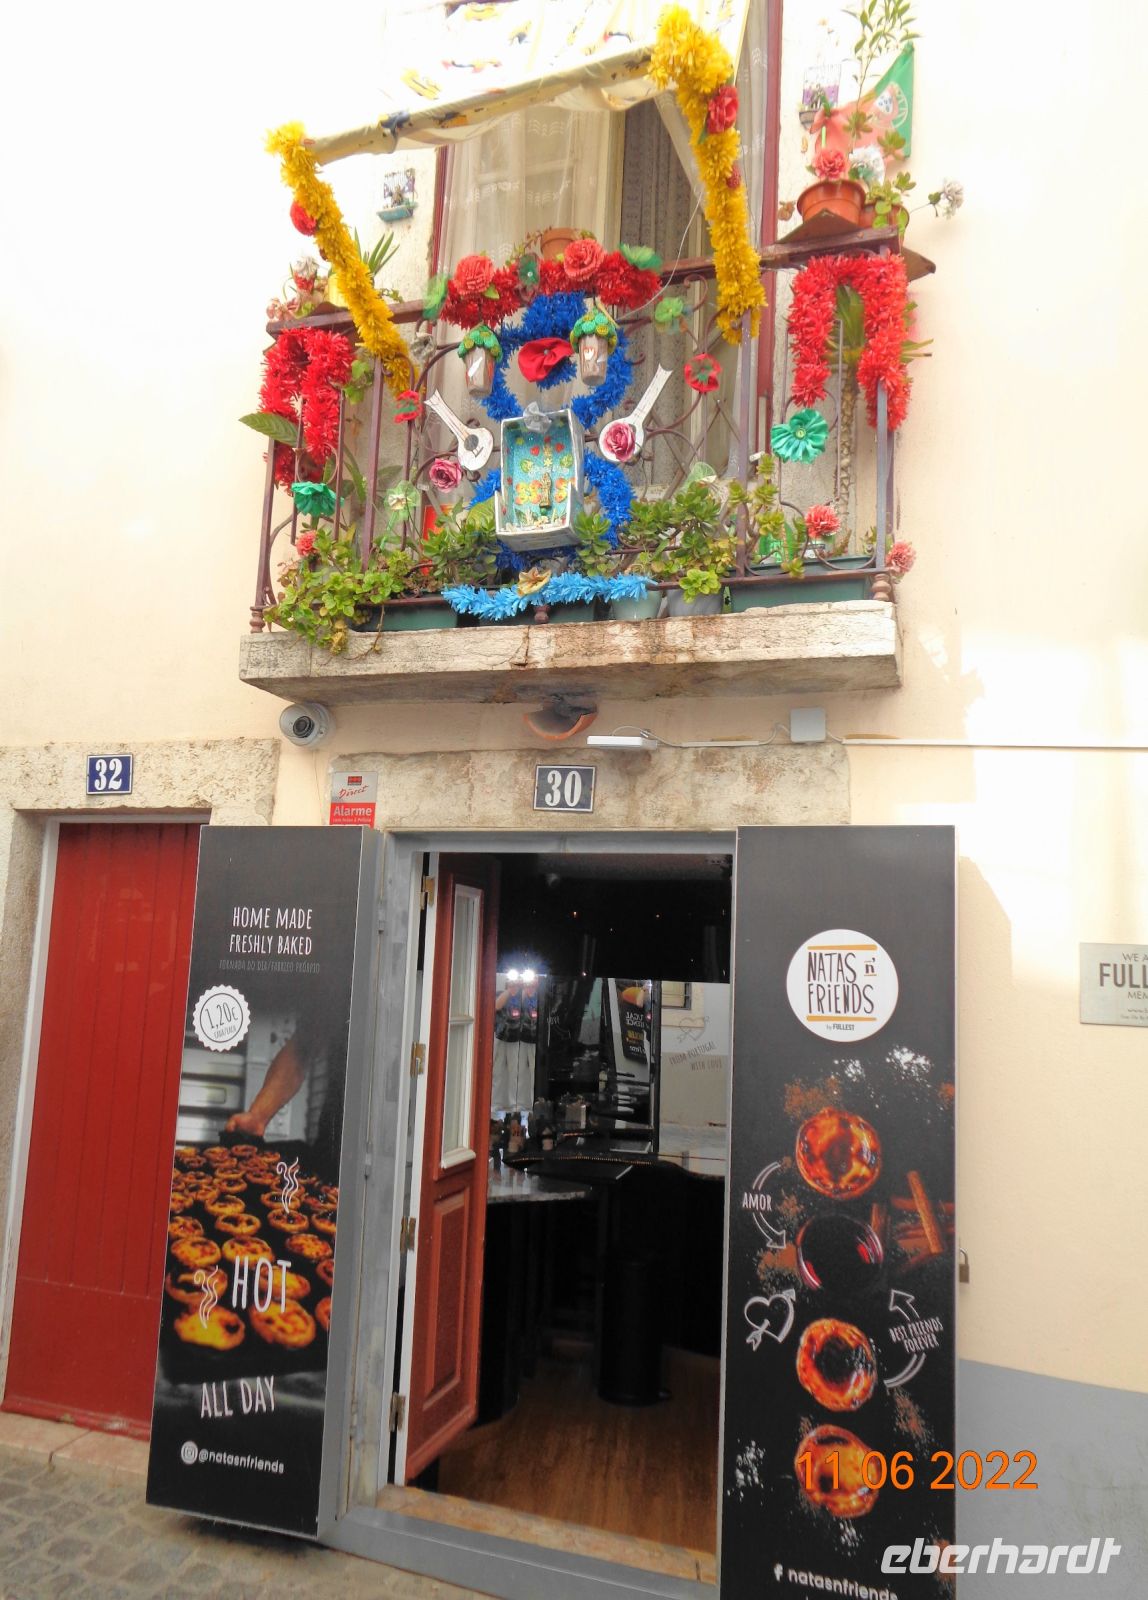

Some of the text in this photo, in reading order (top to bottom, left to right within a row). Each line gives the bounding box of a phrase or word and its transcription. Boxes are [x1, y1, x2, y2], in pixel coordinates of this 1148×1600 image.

[94, 758, 123, 790] 32
[545, 770, 582, 807] 30
[333, 805, 372, 817] Alarme
[232, 906, 313, 930] HOME MADE
[229, 934, 312, 956] FRESHLY BAKED
[1122, 953, 1139, 962] WE
[807, 951, 857, 984] NATAS
[1099, 963, 1148, 989] FULL
[832, 1023, 855, 1031] FULLEST
[742, 1192, 773, 1211] AMOR
[231, 1255, 292, 1313] HOT
[200, 1375, 276, 1418] ALL DAY
[198, 1448, 285, 1474] @natasnfriends
[787, 1568, 899, 1600] natasnfriends
